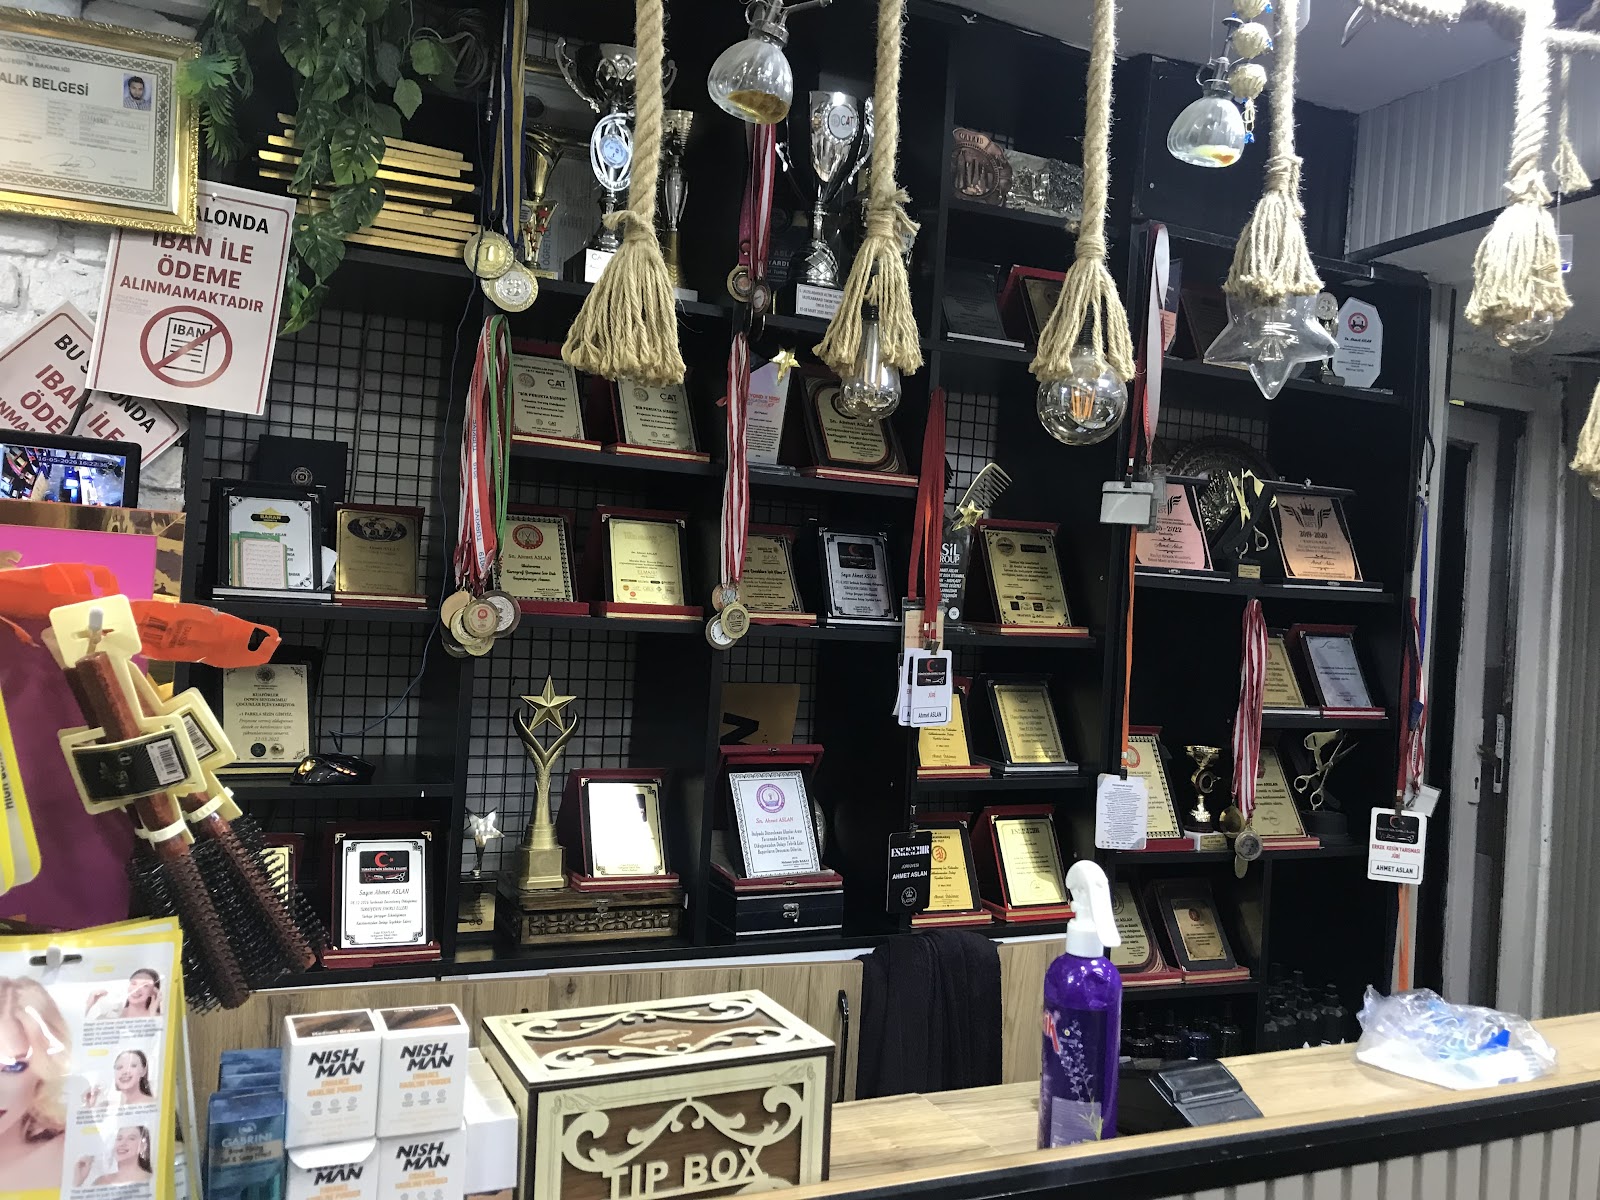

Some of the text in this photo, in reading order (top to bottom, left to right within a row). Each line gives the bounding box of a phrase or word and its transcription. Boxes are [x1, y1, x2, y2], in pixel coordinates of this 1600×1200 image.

[0, 71, 89, 96] ALIK BELGESİ
[841, 115, 854, 127] CAT
[197, 206, 269, 234] ALONDA
[221, 237, 254, 264] İLE
[157, 254, 242, 289] ÖDEME
[120, 275, 264, 313] ALINMAMAKTADIR
[173, 324, 206, 338] IBAN
[54, 334, 85, 361] BU
[547, 378, 566, 388] CAT
[660, 393, 677, 401] CAT
[20, 389, 69, 436] ÖDE
[939, 555, 961, 563] ROUP
[930, 711, 942, 719] ASLAN
[892, 870, 928, 880] AHMET ASLAN
[1395, 866, 1414, 874] ASLAN
[308, 1048, 359, 1066] NISH
[400, 1042, 449, 1059] NISH
[315, 1060, 365, 1079] MAN
[407, 1055, 454, 1072] MAN
[221, 1132, 273, 1148] GABRINI
[396, 1141, 445, 1160] NISH
[402, 1154, 451, 1172] MAN
[313, 1166, 364, 1186] MAN
[602, 1146, 768, 1200] TIP BOX
